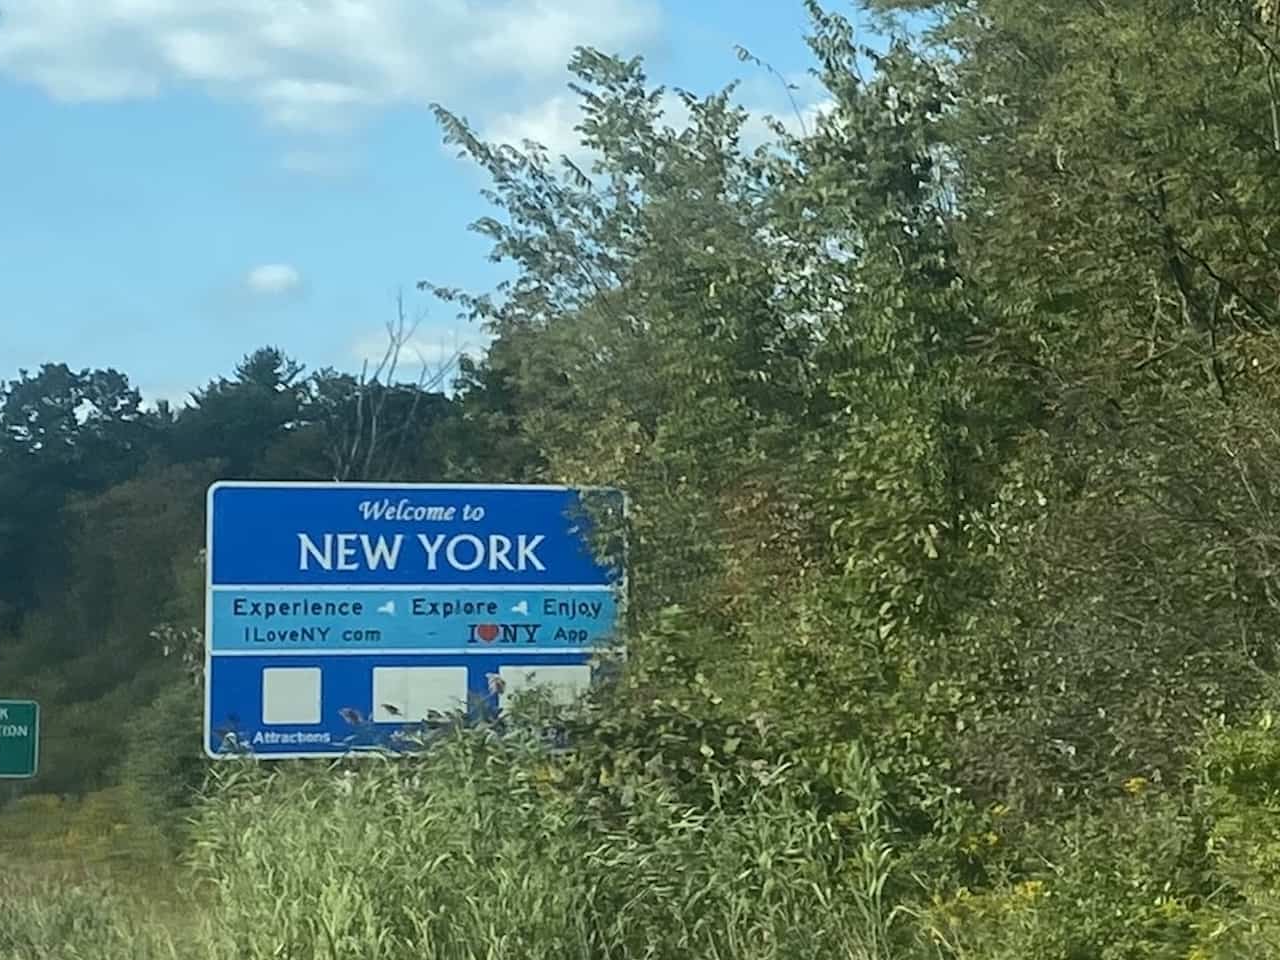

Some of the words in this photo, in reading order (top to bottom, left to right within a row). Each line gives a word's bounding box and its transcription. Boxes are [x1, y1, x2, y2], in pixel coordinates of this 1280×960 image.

[359, 499, 455, 521] Welcome
[463, 503, 485, 521] to
[298, 534, 403, 570] NEW
[417, 534, 546, 572] YORK
[233, 598, 363, 619] Experience
[411, 598, 498, 618] Explore
[544, 598, 602, 619] Enjoy
[554, 627, 589, 643] App
[252, 731, 331, 745] Attractions
